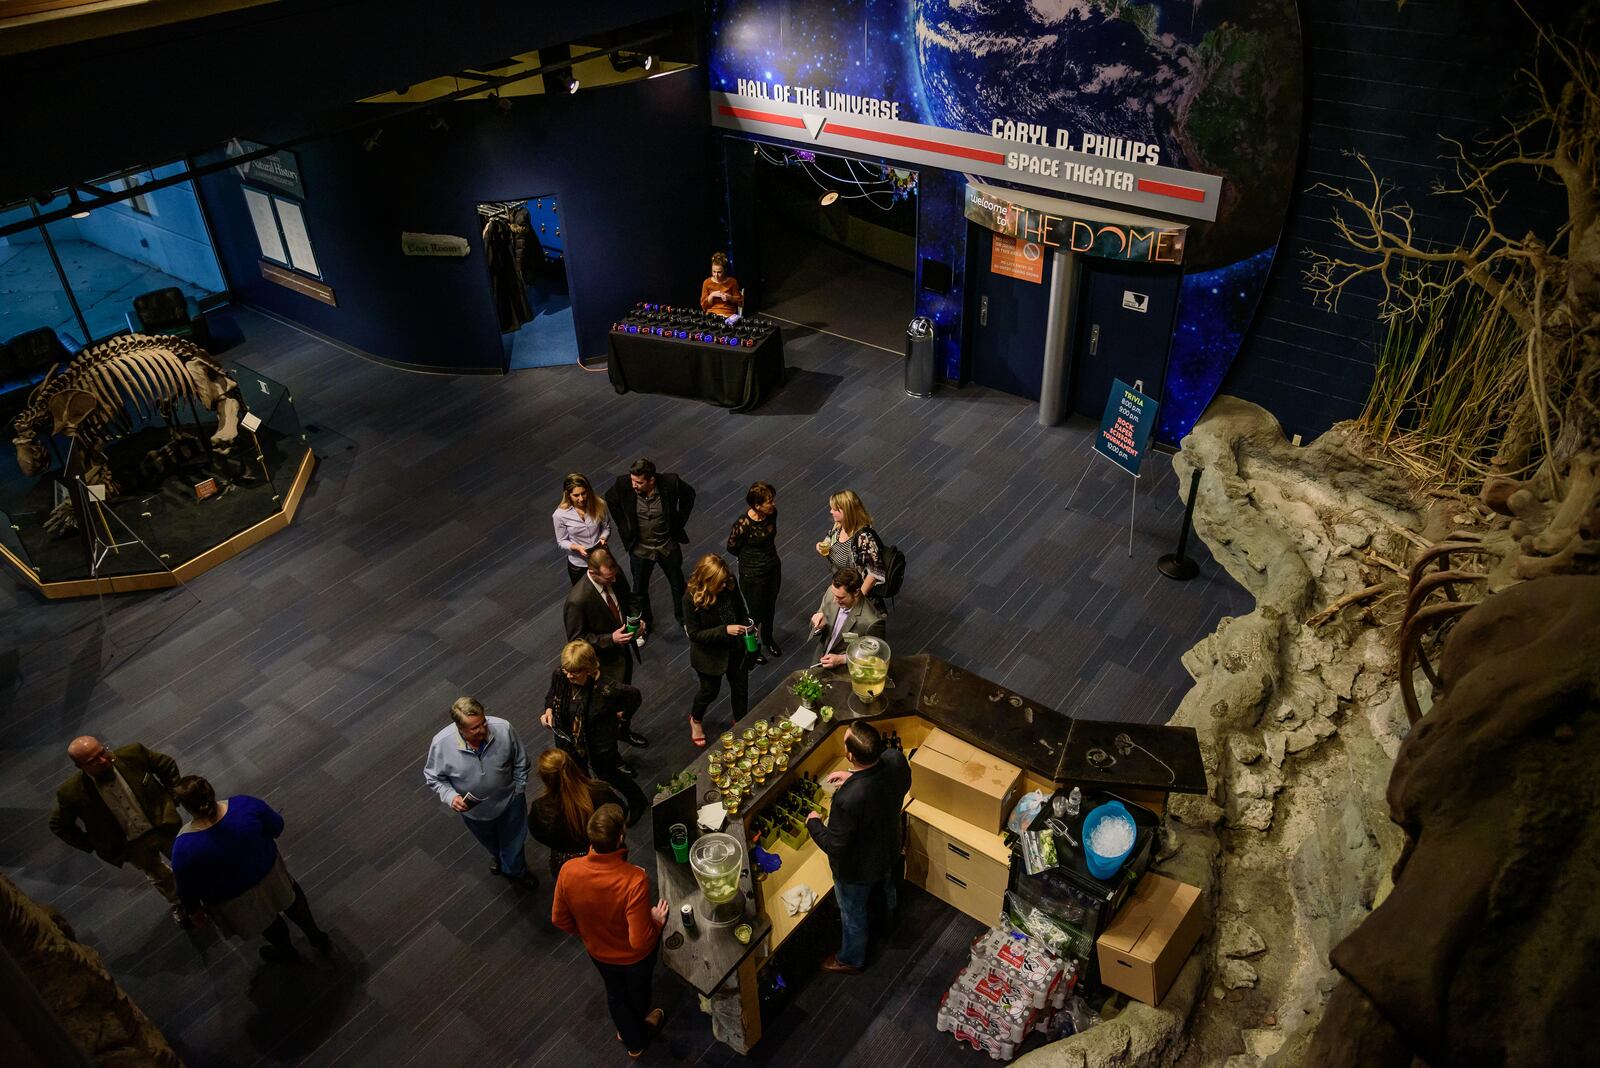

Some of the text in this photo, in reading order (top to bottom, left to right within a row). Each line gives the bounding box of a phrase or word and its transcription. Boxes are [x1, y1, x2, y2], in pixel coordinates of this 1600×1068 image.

[737, 78, 900, 120] HALL OF THE UNIVERSE
[992, 118, 1160, 166] CARYL D. PHILIPS
[274, 162, 298, 182] History
[1007, 151, 1134, 192] SPACE THEATER
[970, 194, 1008, 216] welcome
[997, 215, 1006, 227] to
[1011, 206, 1179, 262] THE DOME
[1121, 397, 1132, 409] 8:00
[1125, 391, 1143, 406] TRIVIA
[1119, 406, 1130, 416] 9:00
[1103, 430, 1138, 456] TOURNAMENT
[1107, 442, 1119, 453] 10:00
[1110, 428, 1135, 448] SCISSORS
